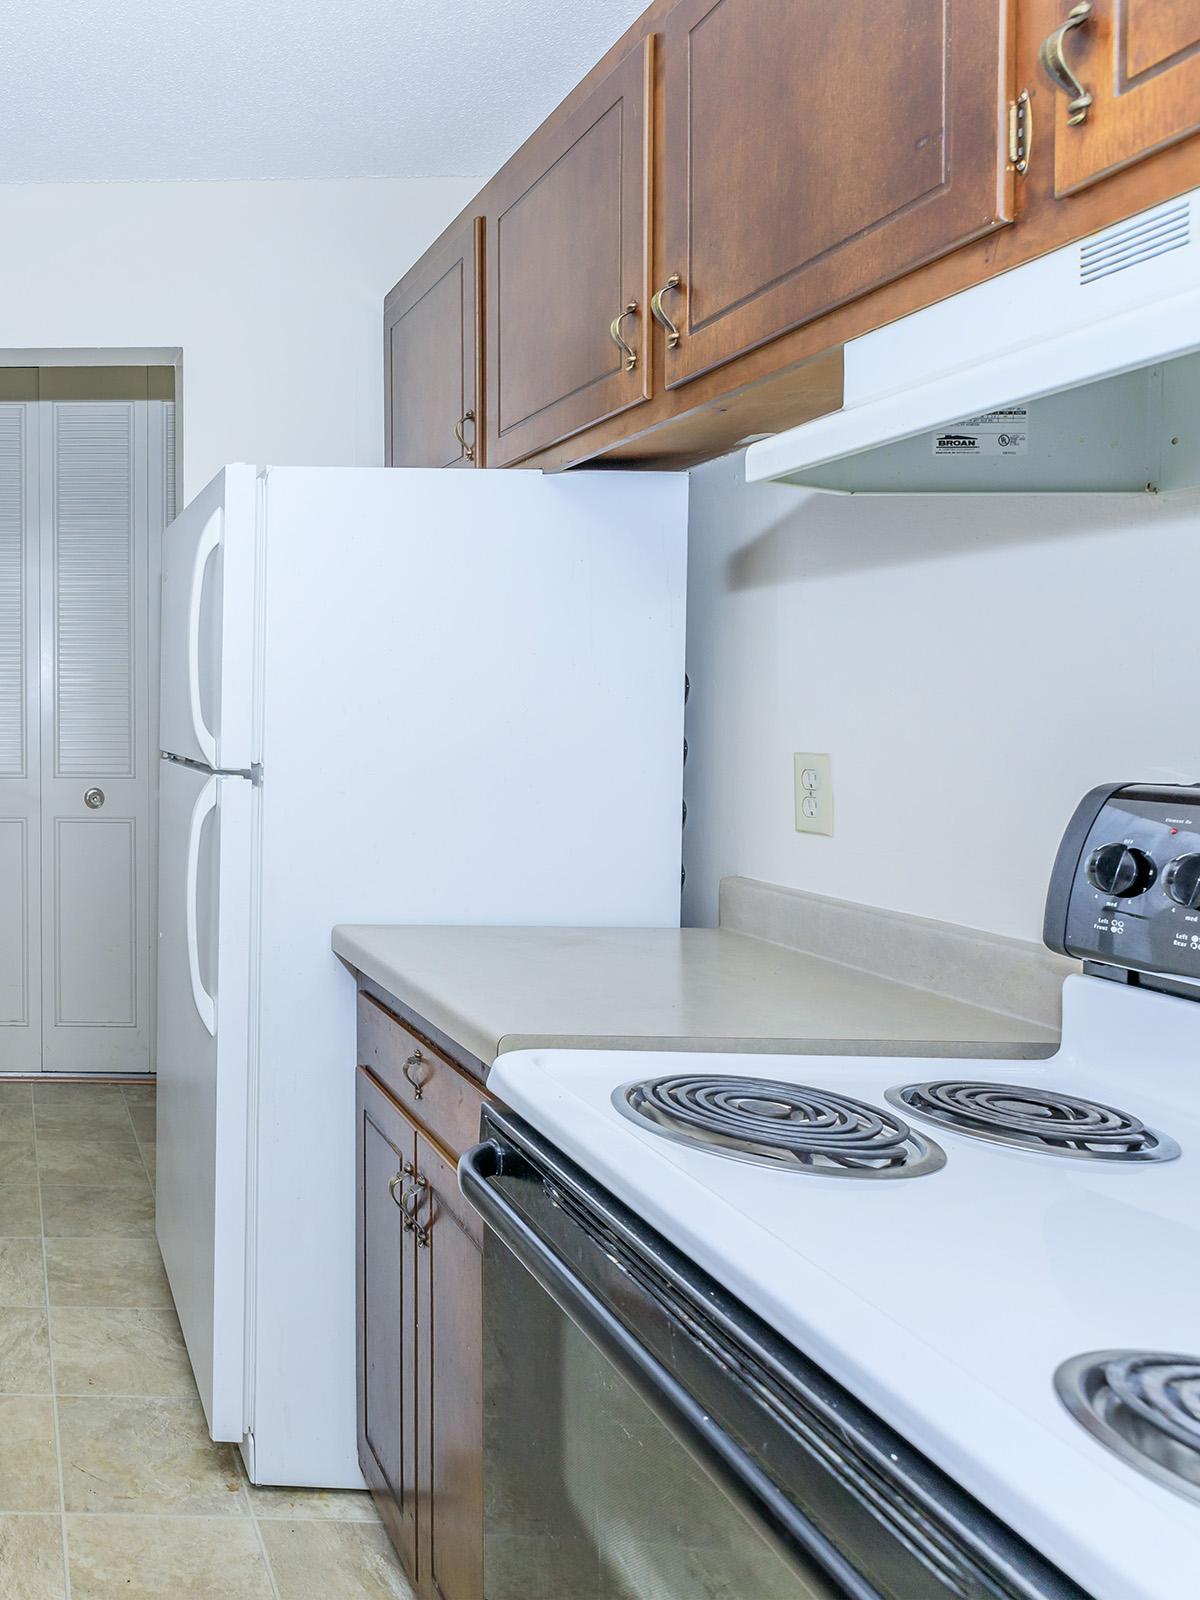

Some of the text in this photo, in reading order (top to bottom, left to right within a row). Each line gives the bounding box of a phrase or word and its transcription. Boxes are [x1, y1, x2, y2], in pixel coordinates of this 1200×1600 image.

[1098, 917, 1109, 925] Left
[1093, 923, 1108, 932] Front
[1175, 932, 1188, 941] Left
[1173, 939, 1188, 948] Rear
